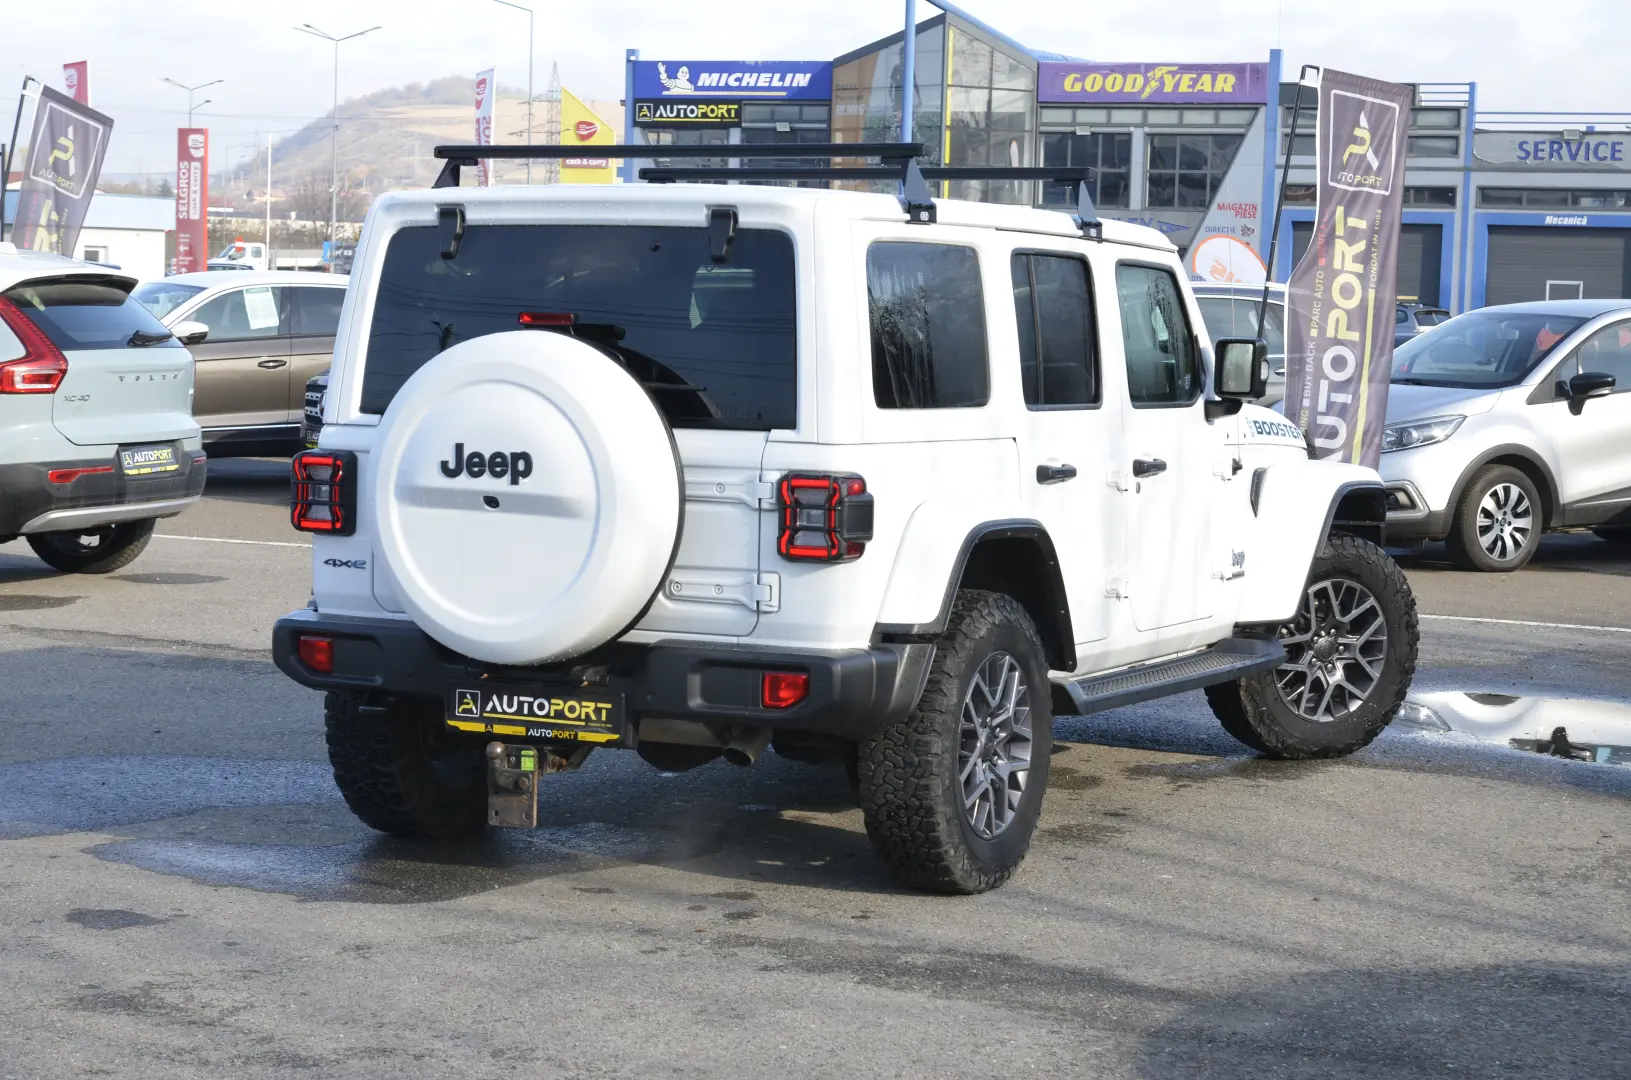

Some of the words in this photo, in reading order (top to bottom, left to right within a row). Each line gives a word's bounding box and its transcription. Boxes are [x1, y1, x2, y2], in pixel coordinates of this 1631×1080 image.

[697, 73, 812, 87] MICHELIN
[655, 105, 739, 118] AUTOPORT
[1516, 140, 1624, 161] SERVICE
[178, 161, 190, 220] SELGROS
[1217, 203, 1257, 211] MAGAZIN
[1234, 211, 1257, 219] PIESE
[1370, 246, 1379, 288] FONDAT
[1314, 270, 1325, 299] AUTO
[1311, 300, 1322, 329] PARC
[1314, 205, 1368, 462] UTOPORT
[1305, 340, 1317, 372] BACK
[118, 374, 178, 382] VOLVO
[1303, 376, 1313, 397] BUY
[134, 449, 172, 462] AUTOPORT
[441, 443, 533, 485] Jeep
[485, 694, 613, 721] AUTOPORT
[528, 728, 576, 740] AUTOPORT
